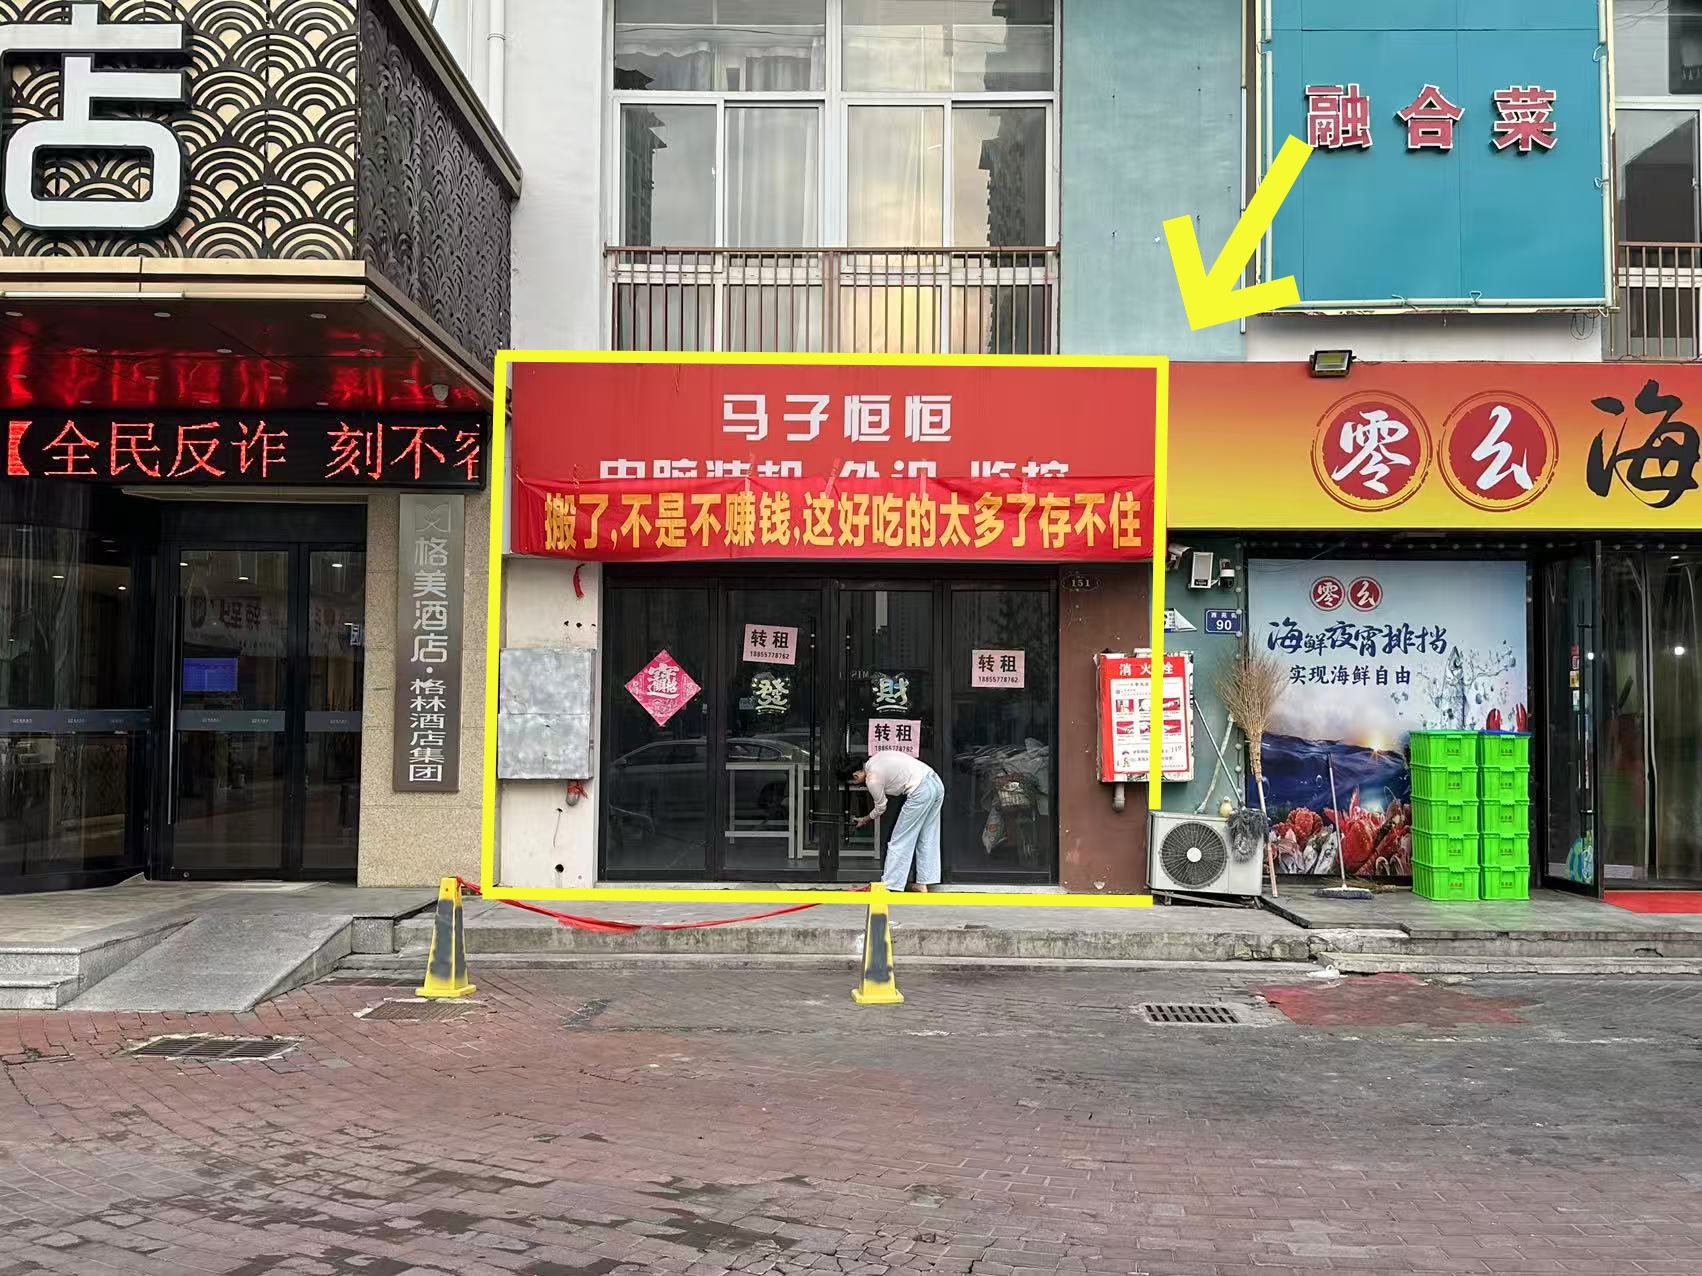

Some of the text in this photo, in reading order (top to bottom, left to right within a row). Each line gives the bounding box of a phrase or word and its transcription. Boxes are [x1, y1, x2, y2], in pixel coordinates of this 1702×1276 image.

[1305, 84, 1557, 151] 融合菜
[722, 394, 952, 442] 马子恒恒
[1071, 579, 1090, 587] 151
[1216, 619, 1232, 630] 90
[750, 629, 789, 648] 转租
[978, 654, 1017, 672] 转租
[1289, 664, 1411, 686] 实现海鲜自由
[874, 723, 912, 742] 转租
